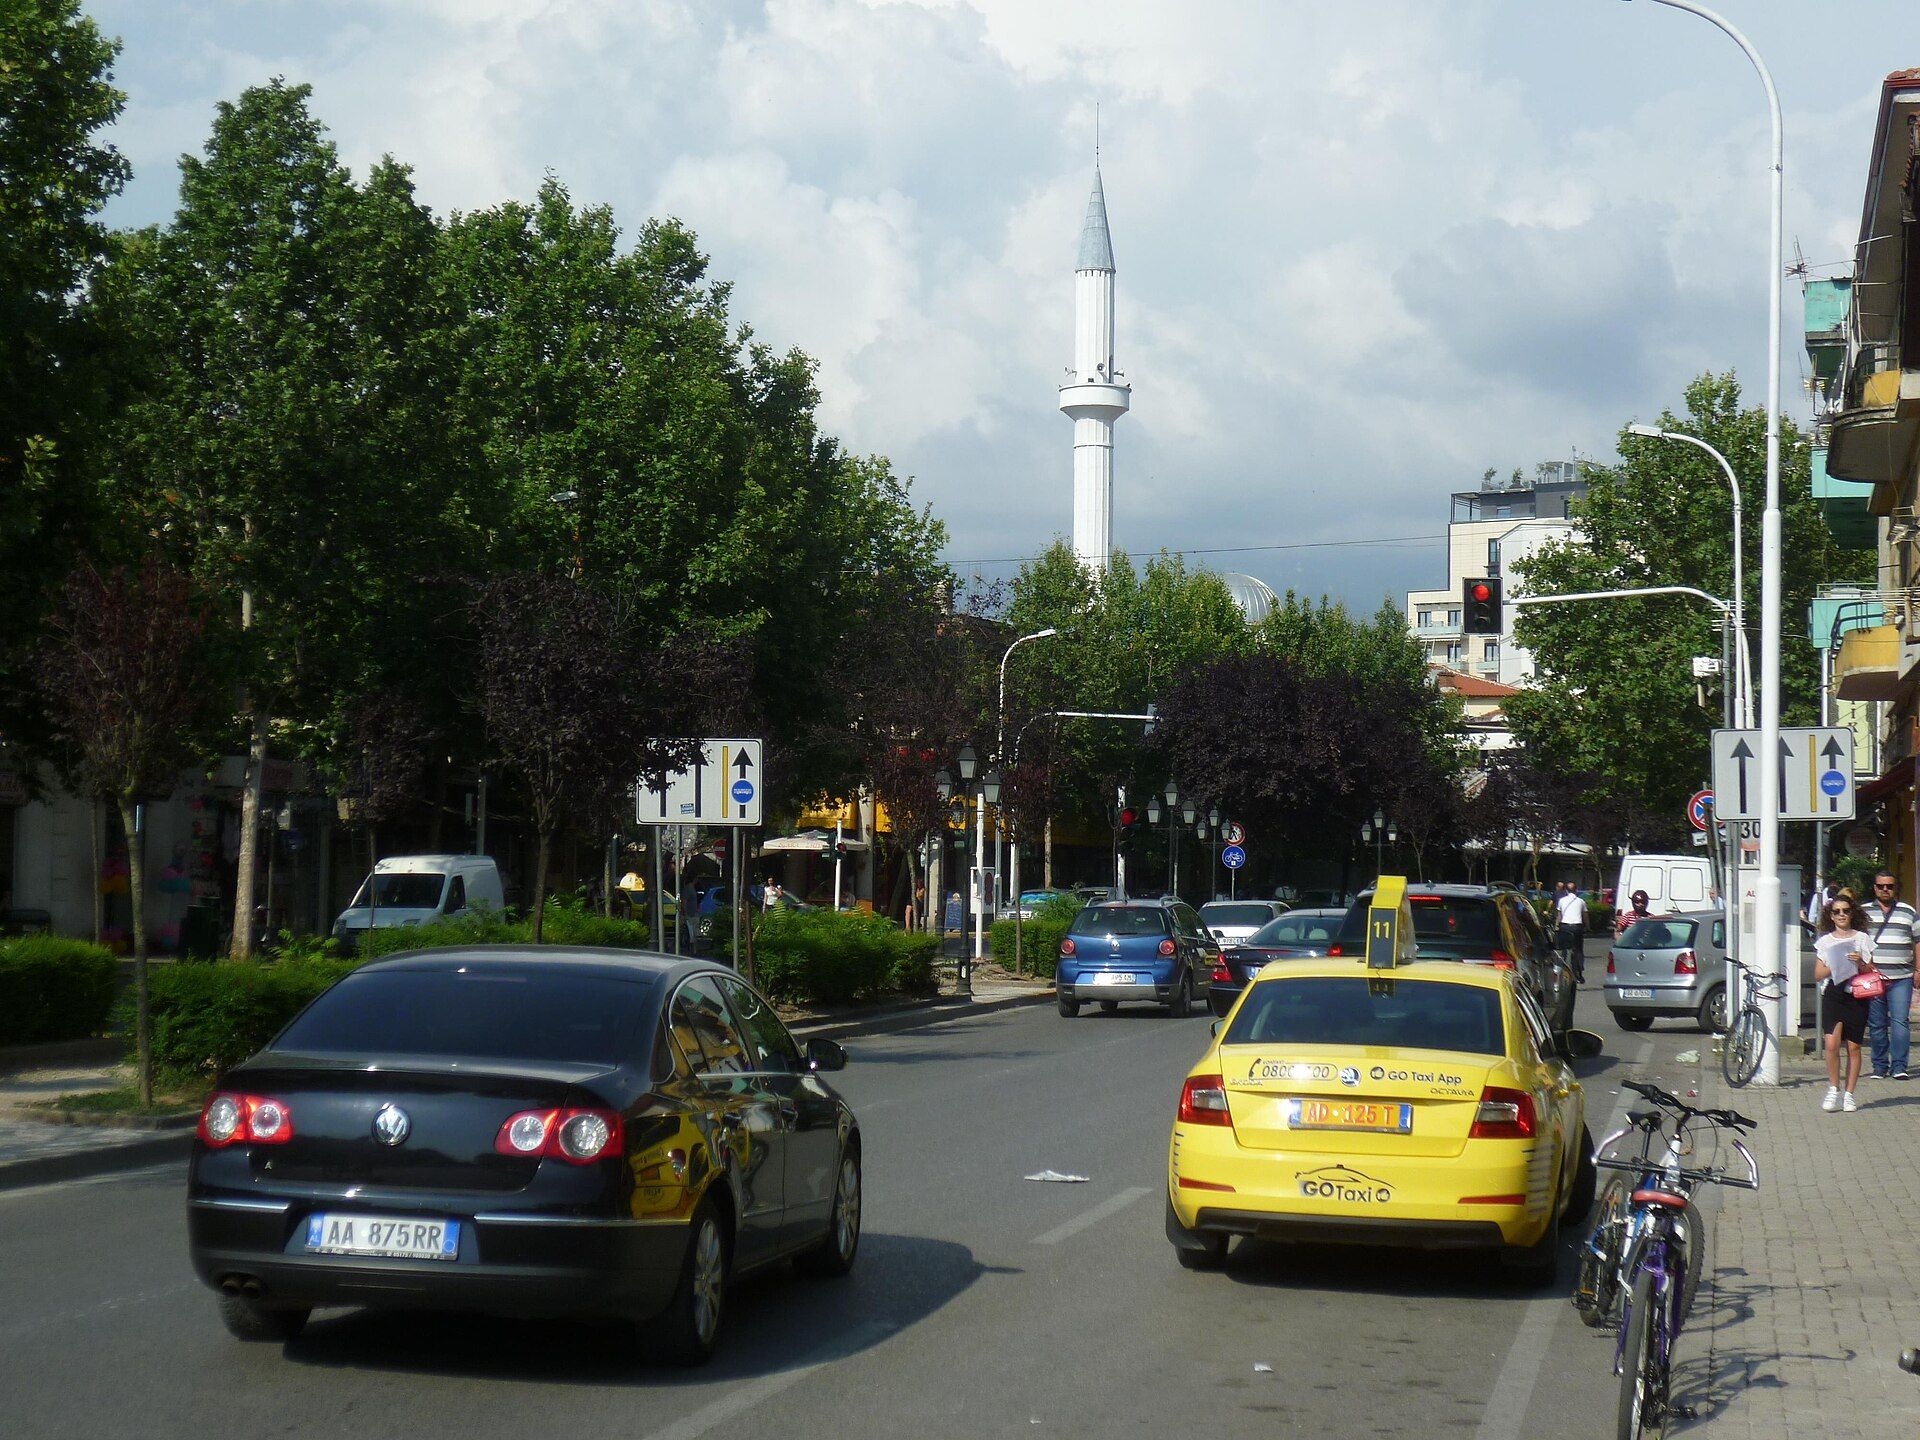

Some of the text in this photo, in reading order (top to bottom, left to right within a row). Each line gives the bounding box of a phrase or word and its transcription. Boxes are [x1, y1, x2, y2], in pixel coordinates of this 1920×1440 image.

[1740, 821, 1761, 839] 30
[1373, 921, 1390, 939] 11
[1388, 1070, 1463, 1086] GO Taxi App
[1429, 1087, 1476, 1097] OCTAVIA
[1306, 1103, 1394, 1125] AD 125 T
[327, 1220, 442, 1250] AA 875RR
